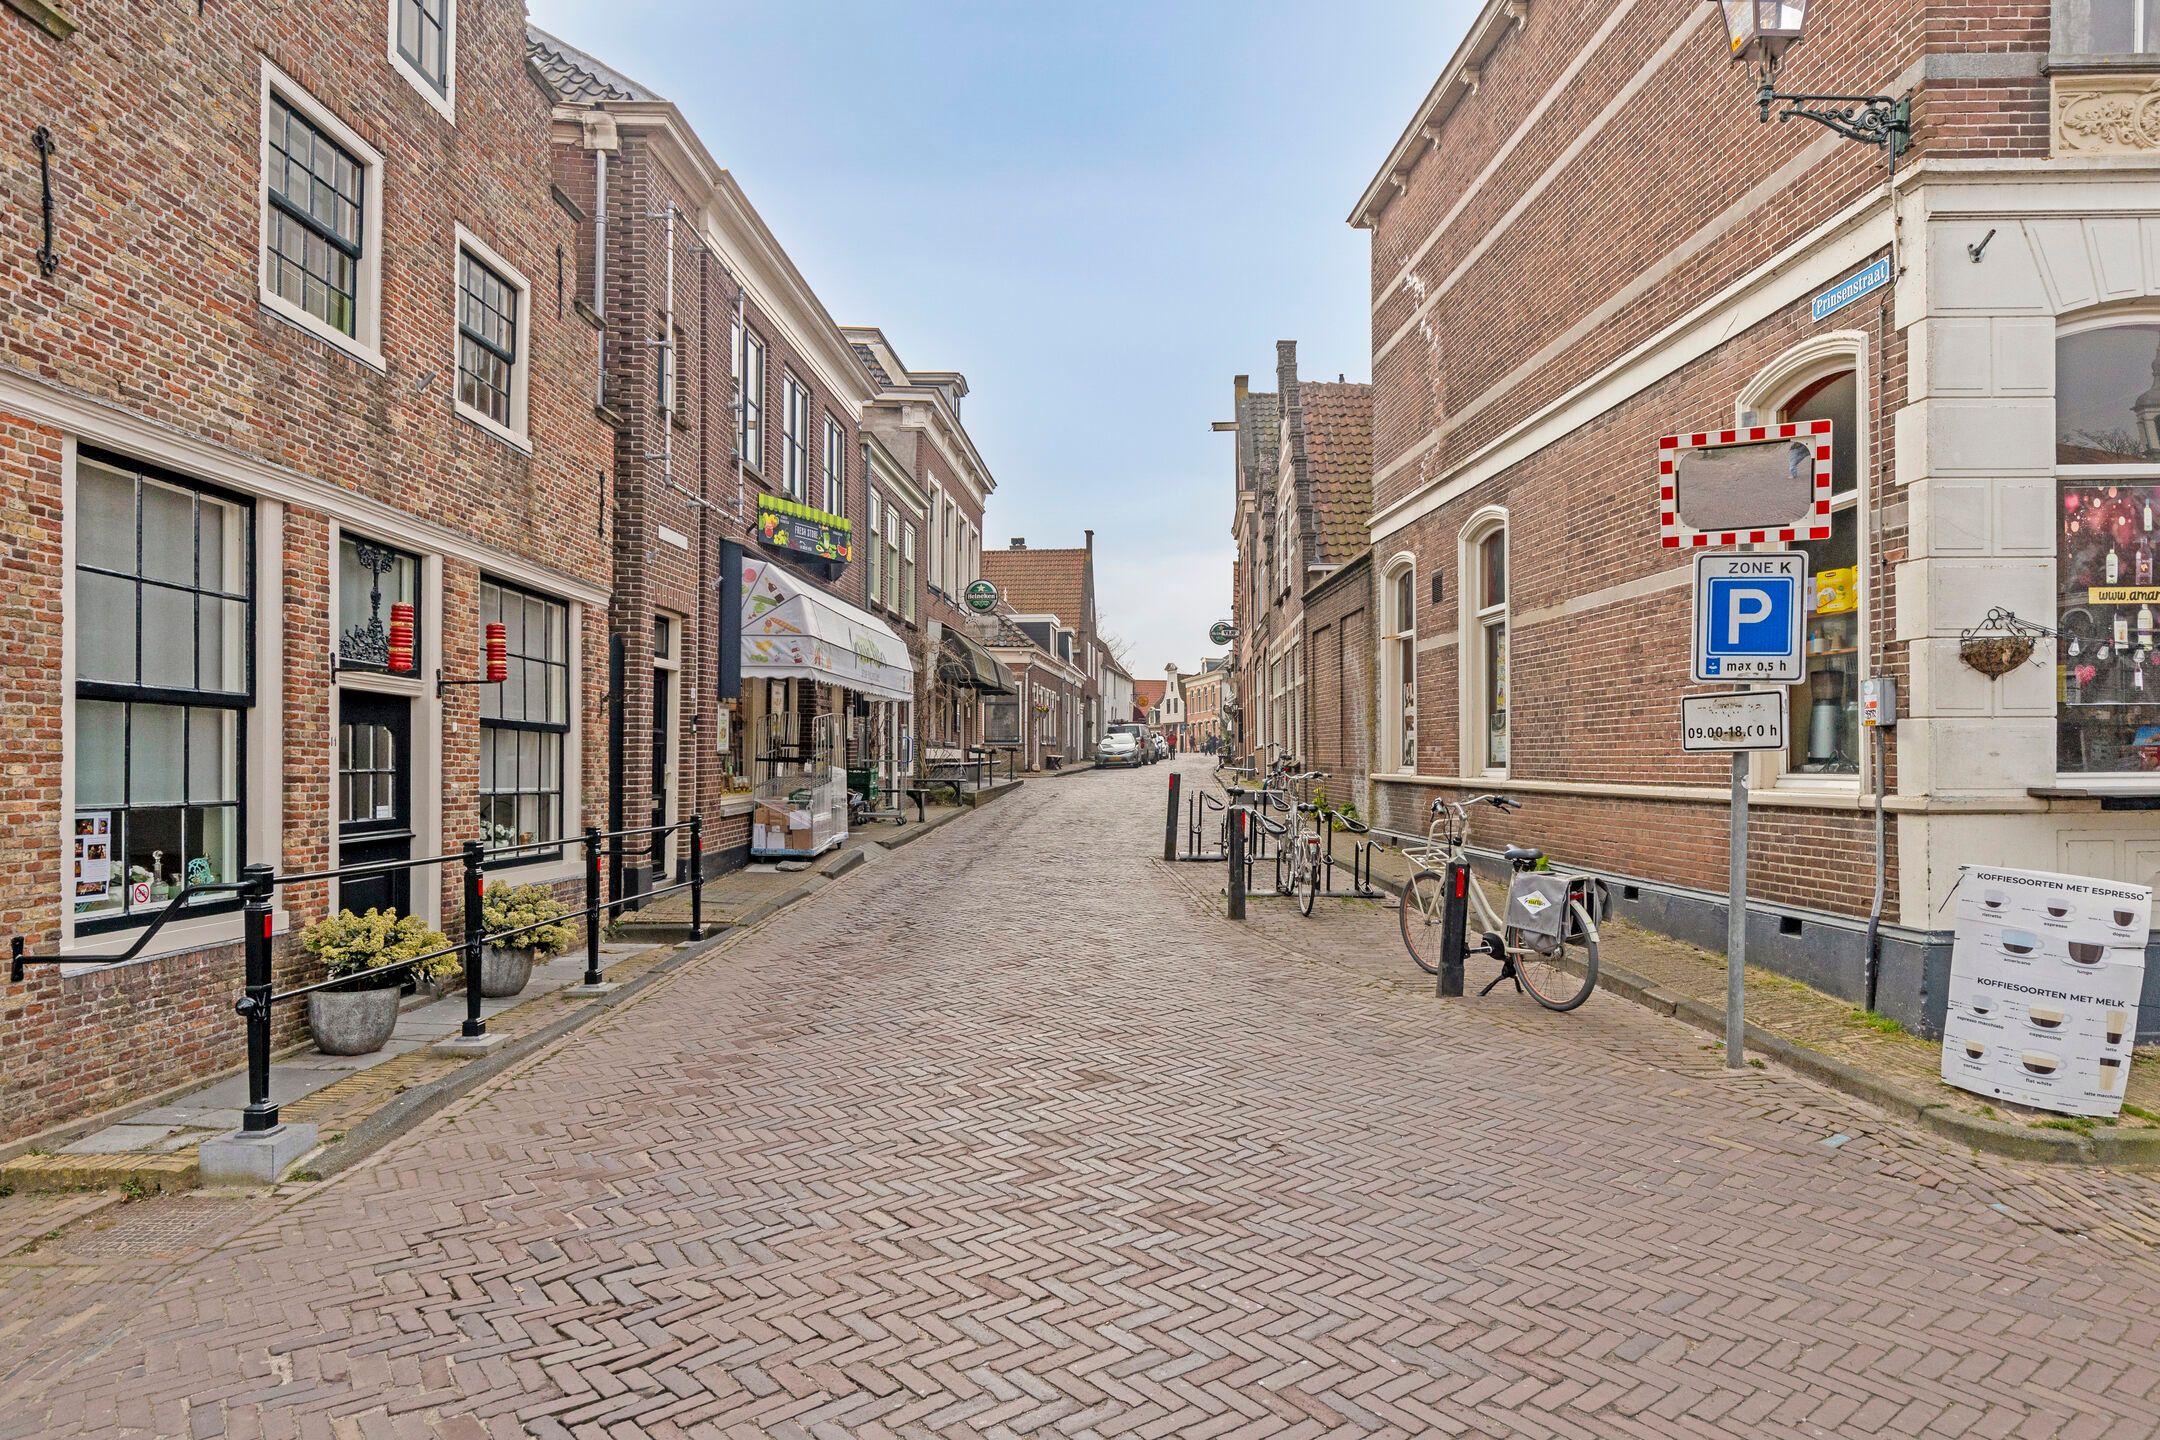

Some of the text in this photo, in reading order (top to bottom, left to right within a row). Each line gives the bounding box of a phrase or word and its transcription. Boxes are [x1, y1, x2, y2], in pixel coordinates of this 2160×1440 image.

[1816, 264, 1885, 315] Prinsenstraat
[794, 525, 807, 537] FRESH
[1728, 561, 1792, 574] ZONE K
[1727, 588, 1773, 645] P
[1726, 661, 1752, 672] max
[1779, 660, 1787, 671] h
[1770, 724, 1777, 737] h
[1976, 872, 2145, 901] KOFFIESOORTEN MET ESPRESSO
[1981, 912, 2002, 920] ristretto
[2112, 931, 2131, 939] doppio
[2003, 957, 2031, 966] americano
[1977, 976, 2125, 1008] KOFFIESOORTEN MET MELK
[1956, 1015, 2005, 1030] espresso macchiato
[2028, 1031, 2062, 1042] cappuccino
[1963, 1063, 1982, 1072] cortado
[2036, 1080, 2053, 1088] white
[2083, 1090, 2123, 1101] latte macchiato
